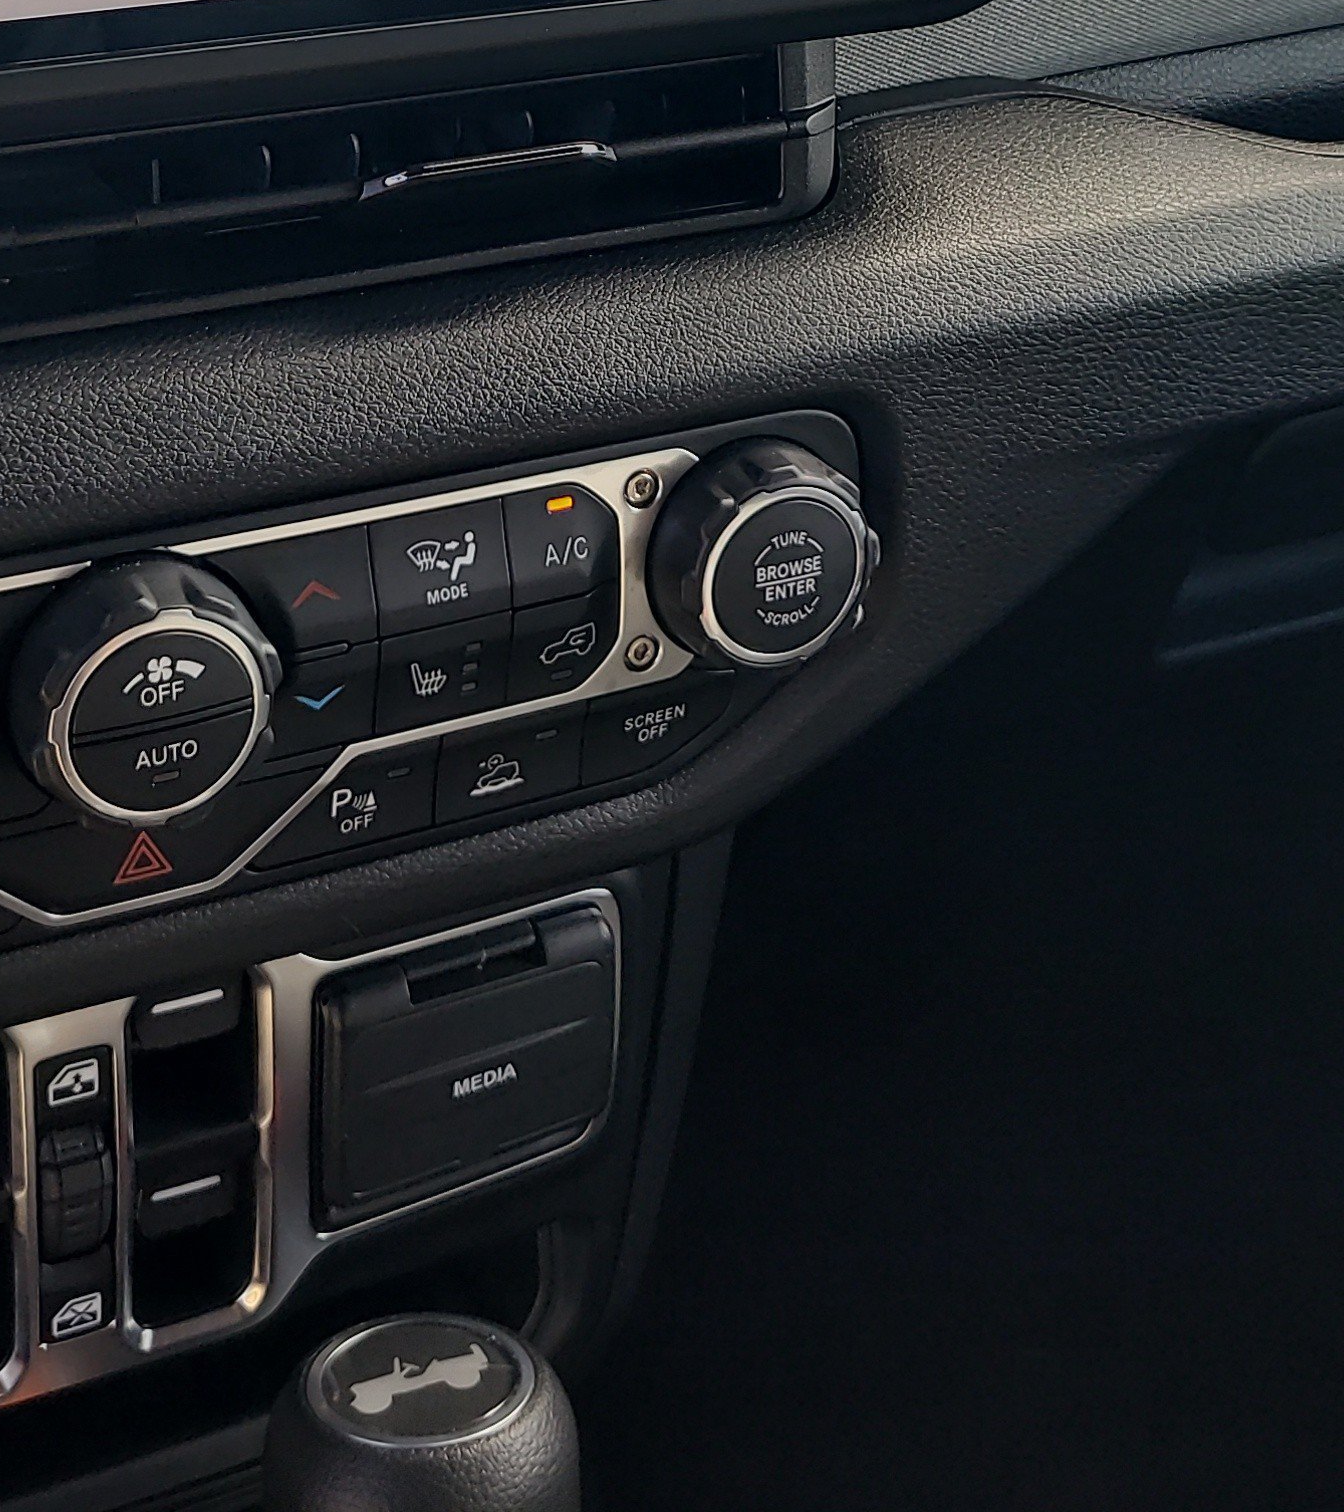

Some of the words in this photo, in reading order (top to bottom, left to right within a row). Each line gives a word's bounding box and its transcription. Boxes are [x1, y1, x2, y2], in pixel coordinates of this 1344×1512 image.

[543, 535, 590, 568] A/C
[770, 530, 808, 550] TUNE
[755, 554, 822, 583] BROWSE
[426, 582, 470, 606] MODE
[764, 577, 817, 603] ENTER
[763, 604, 815, 627] SCROLL
[140, 679, 186, 709] OFF
[623, 703, 686, 733] SCREEN
[637, 721, 670, 744] OFF
[134, 738, 199, 772] AUTO
[339, 811, 376, 835] OFF
[452, 1061, 518, 1099] MEDIA
